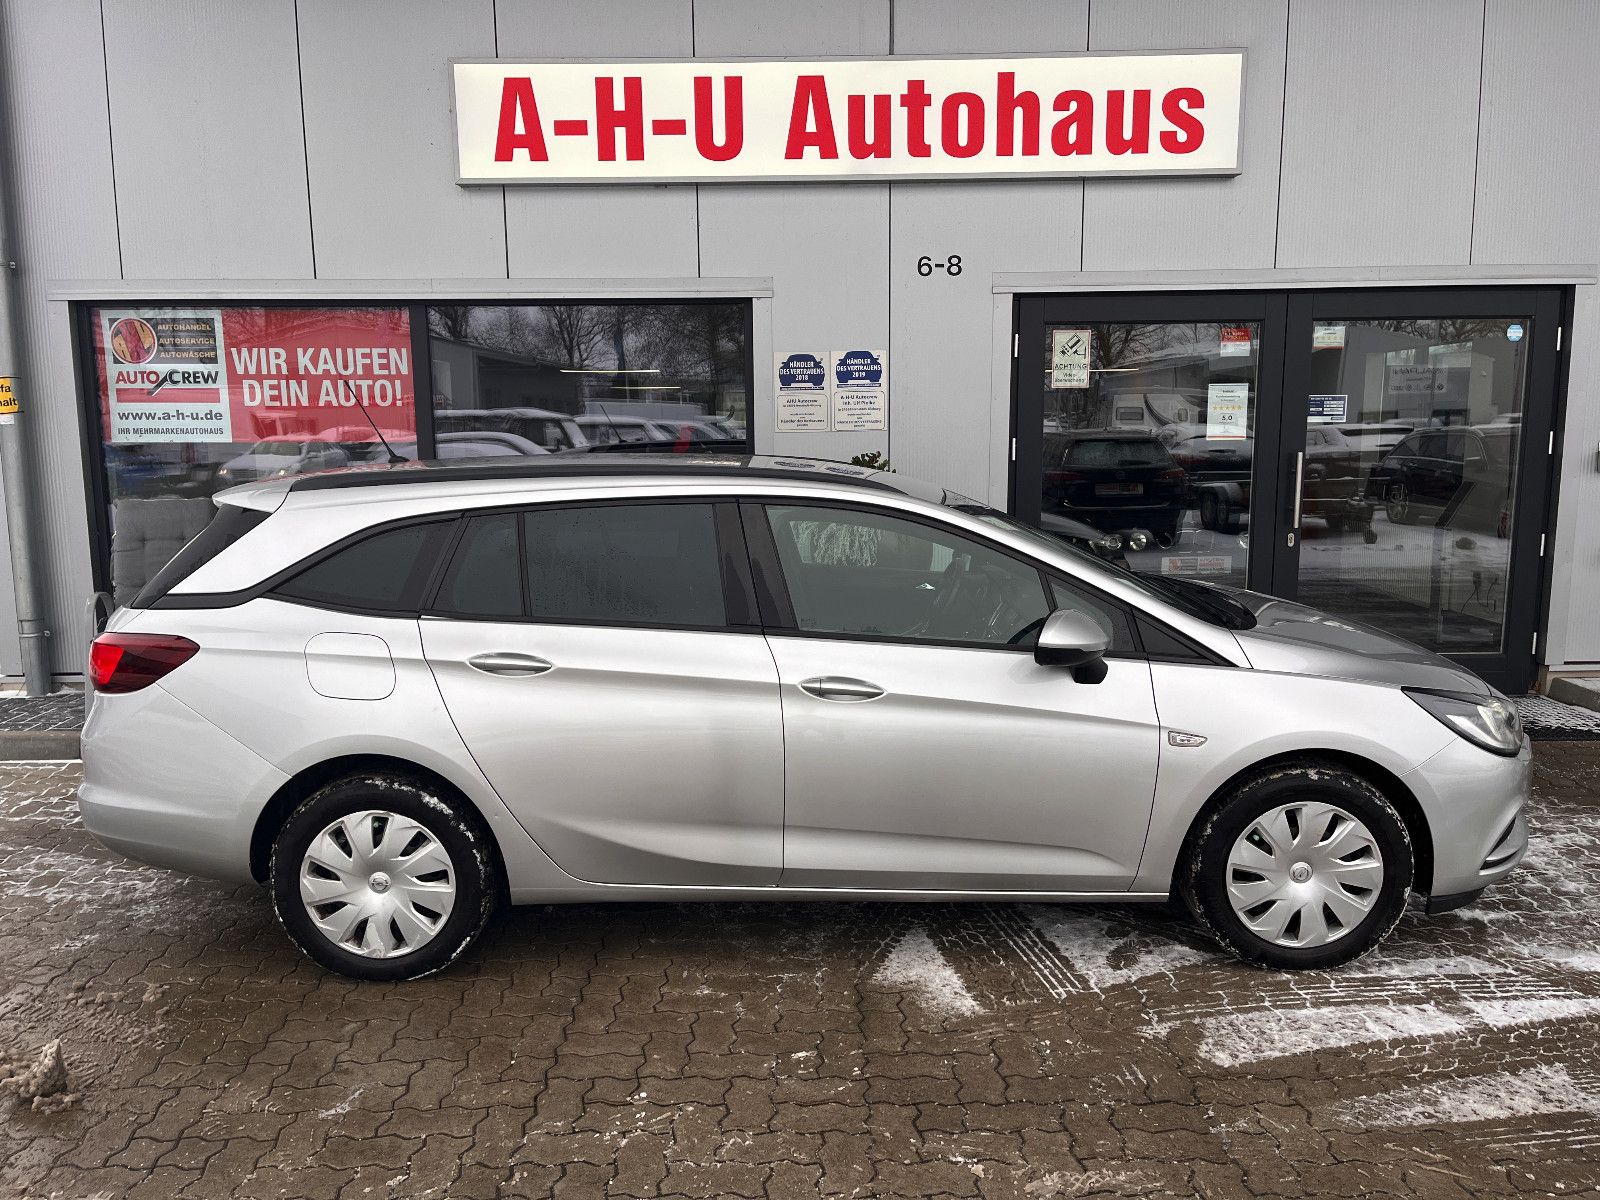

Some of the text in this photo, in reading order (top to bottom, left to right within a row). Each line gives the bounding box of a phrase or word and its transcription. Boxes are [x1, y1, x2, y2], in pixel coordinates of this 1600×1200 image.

[494, 71, 1205, 163] A-H-U Autohaus
[917, 254, 962, 277] 6-8
[158, 337, 215, 345] AUTOSERVICE
[230, 347, 409, 376] WIR KAUFEN
[848, 364, 881, 372] VERTRAUENS
[115, 370, 219, 385] AUTO CREW
[242, 379, 403, 407] DEIN AUTO!
[117, 409, 224, 421] www.a-h-u.de
[117, 427, 224, 435] IHR MEHRMARKENAUTOHAUS
